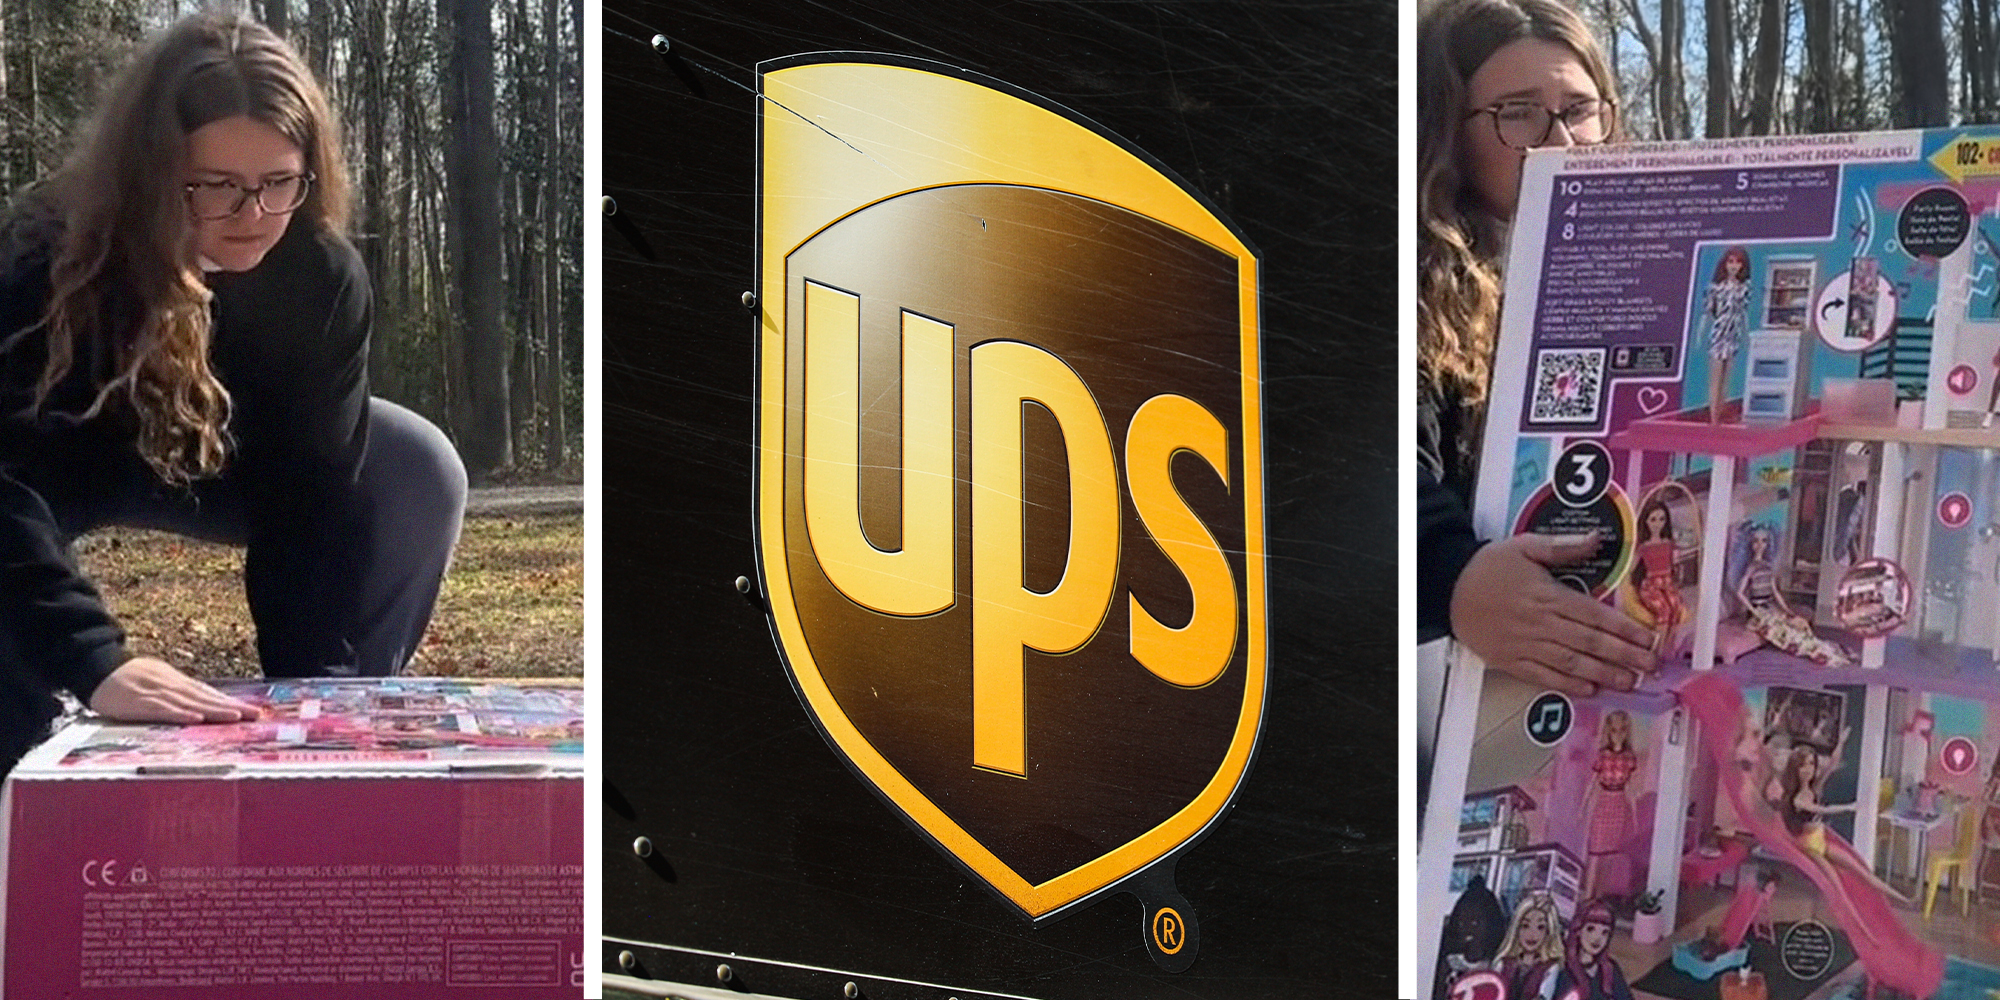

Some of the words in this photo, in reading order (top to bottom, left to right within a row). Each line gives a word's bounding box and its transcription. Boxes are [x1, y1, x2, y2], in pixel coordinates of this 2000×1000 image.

[1743, 150, 1812, 164] TOTALMENTE
[1560, 181, 1582, 196] 10
[1735, 171, 1749, 190] 5
[1564, 201, 1578, 218] 4
[1561, 222, 1575, 240] 8
[1565, 454, 1598, 496] 3
[803, 276, 1239, 780] ups
[83, 859, 118, 887] CE
